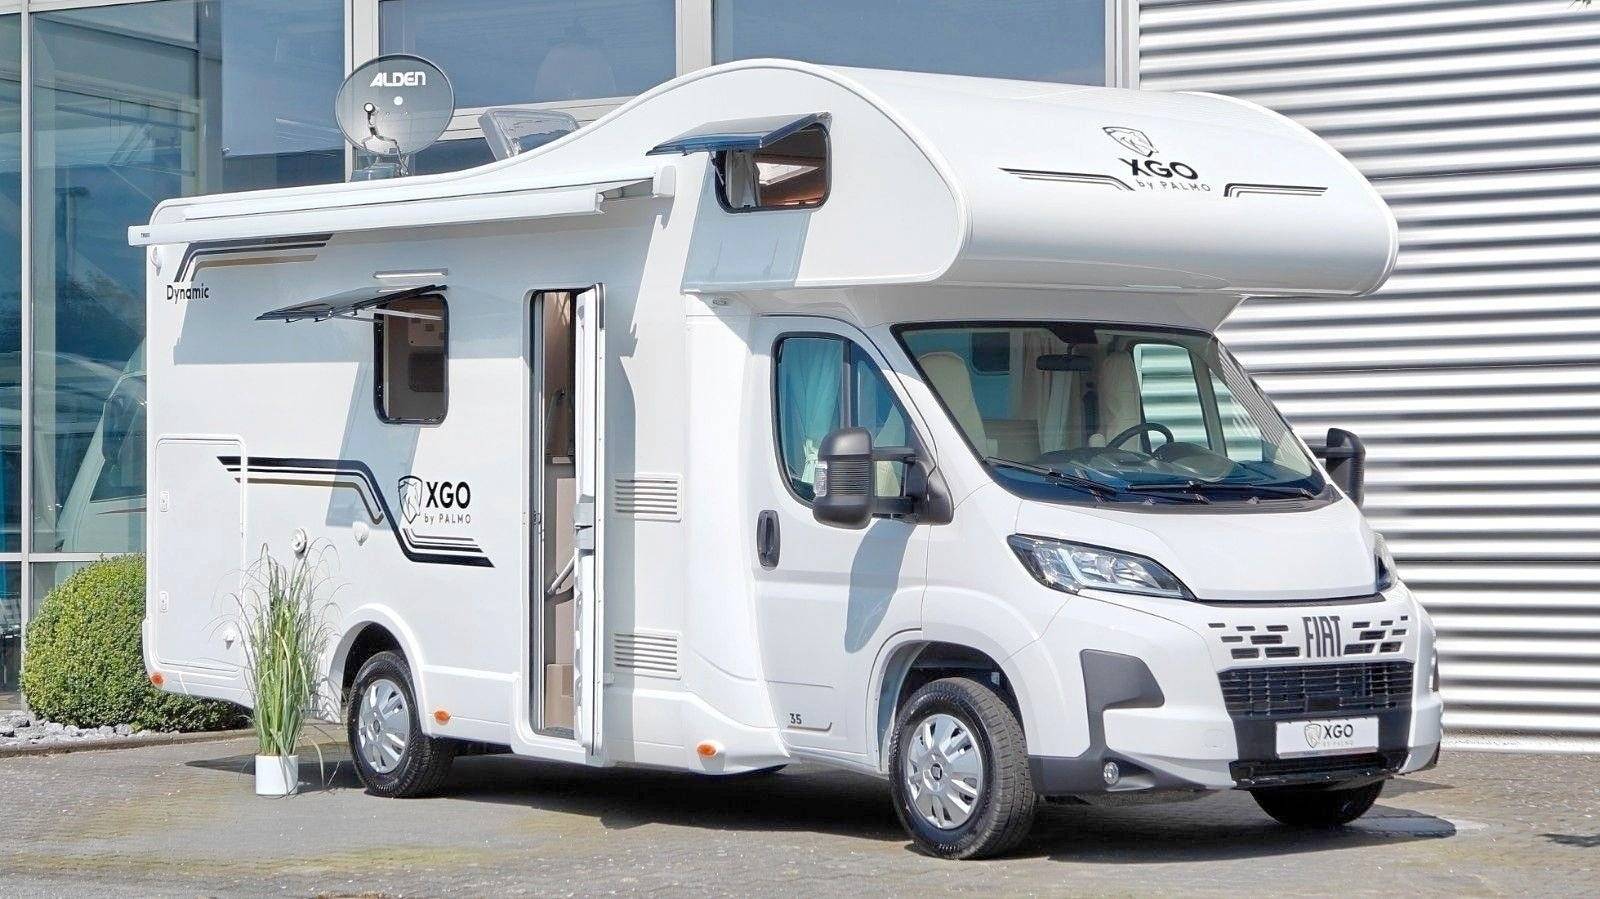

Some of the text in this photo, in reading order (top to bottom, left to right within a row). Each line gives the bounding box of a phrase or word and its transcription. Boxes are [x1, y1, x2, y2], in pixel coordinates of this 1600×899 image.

[369, 71, 427, 87] ALDEN
[1118, 158, 1198, 180] XGO
[1136, 179, 1211, 191] by PALMO
[166, 283, 209, 304] Dynamic
[426, 481, 471, 509] XGO
[424, 513, 471, 525] by PALMO
[1302, 616, 1341, 658] FIAT
[789, 712, 802, 724] 35
[1323, 724, 1354, 739] XGO
